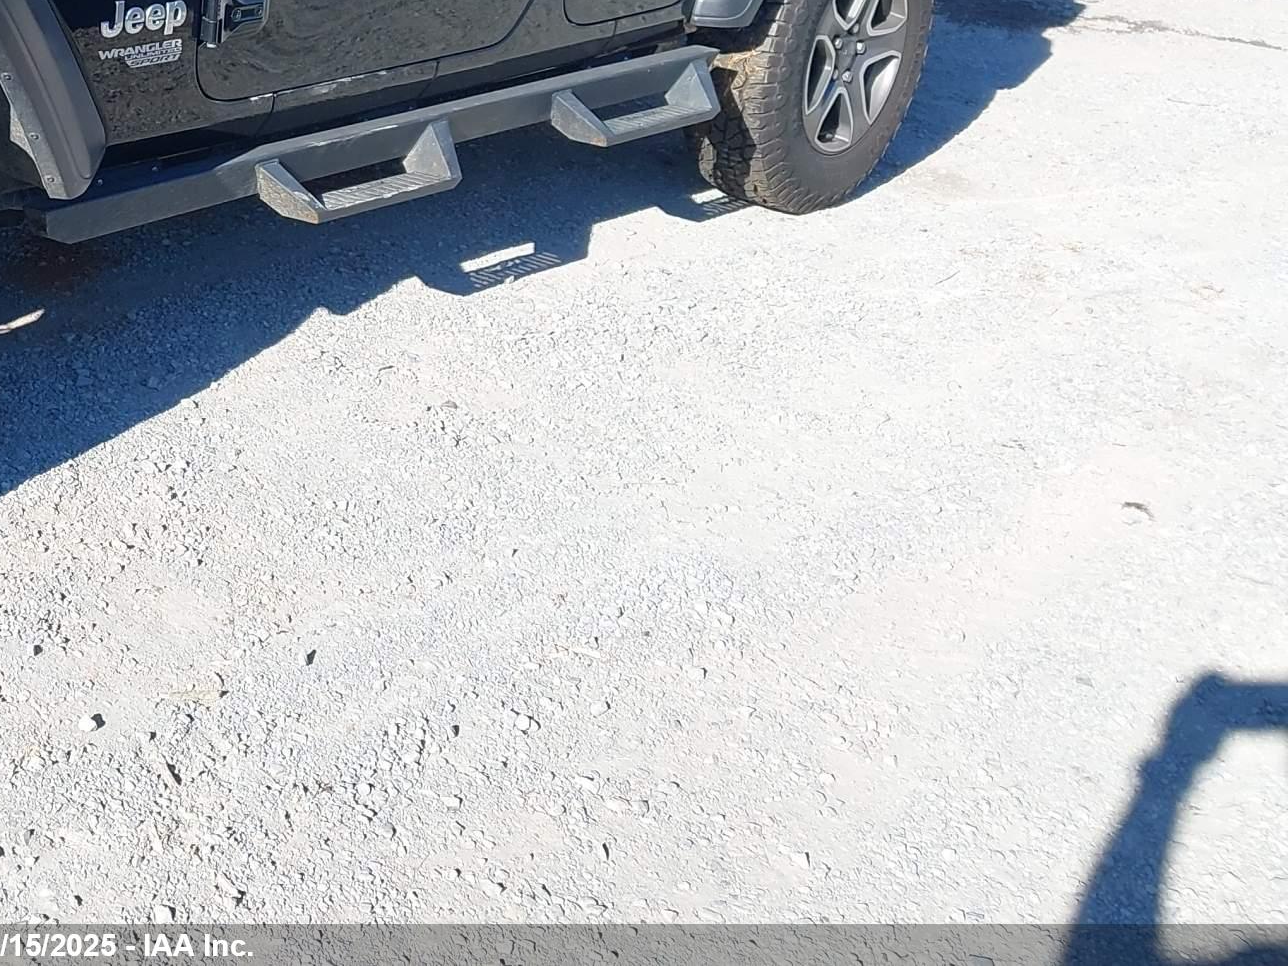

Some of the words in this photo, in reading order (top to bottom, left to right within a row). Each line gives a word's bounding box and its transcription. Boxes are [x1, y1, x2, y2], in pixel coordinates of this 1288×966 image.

[100, 0, 187, 38] Jeep
[98, 38, 183, 60] WRANGLER
[124, 46, 183, 61] UNLIMITED
